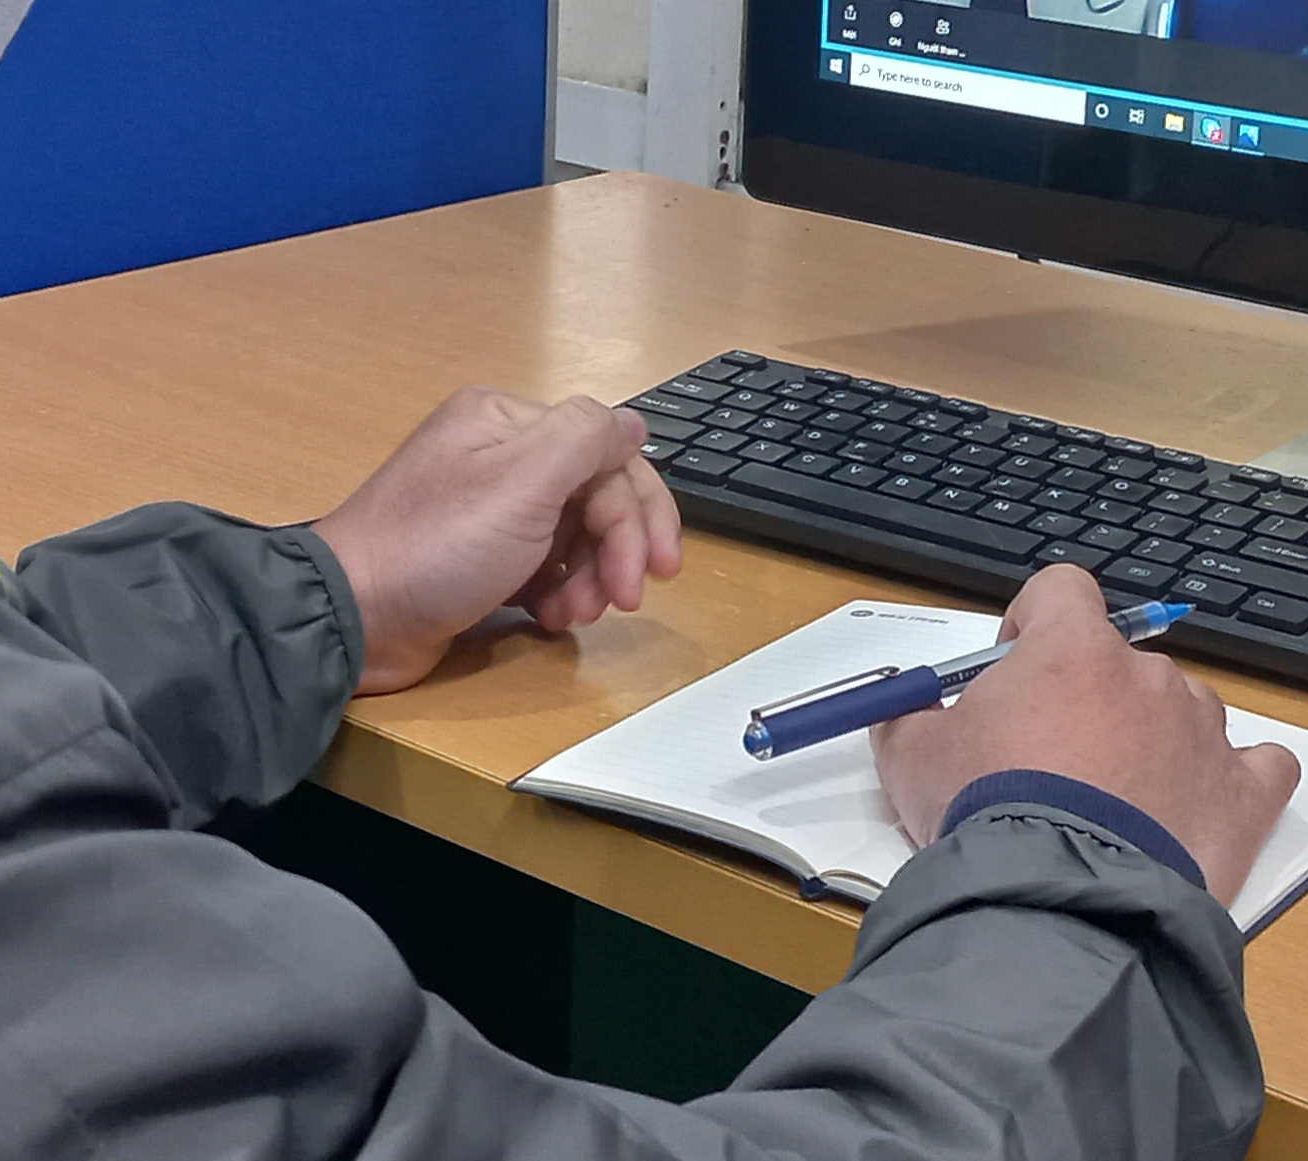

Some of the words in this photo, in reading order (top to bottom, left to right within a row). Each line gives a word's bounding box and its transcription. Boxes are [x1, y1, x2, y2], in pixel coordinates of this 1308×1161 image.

[877, 68, 898, 83] Type
[899, 74, 920, 87] here
[921, 77, 932, 88] to
[933, 80, 963, 93] search
[1014, 457, 1030, 467] U
[945, 489, 960, 500] N
[1047, 489, 1063, 499] K
[1165, 493, 1180, 502] P
